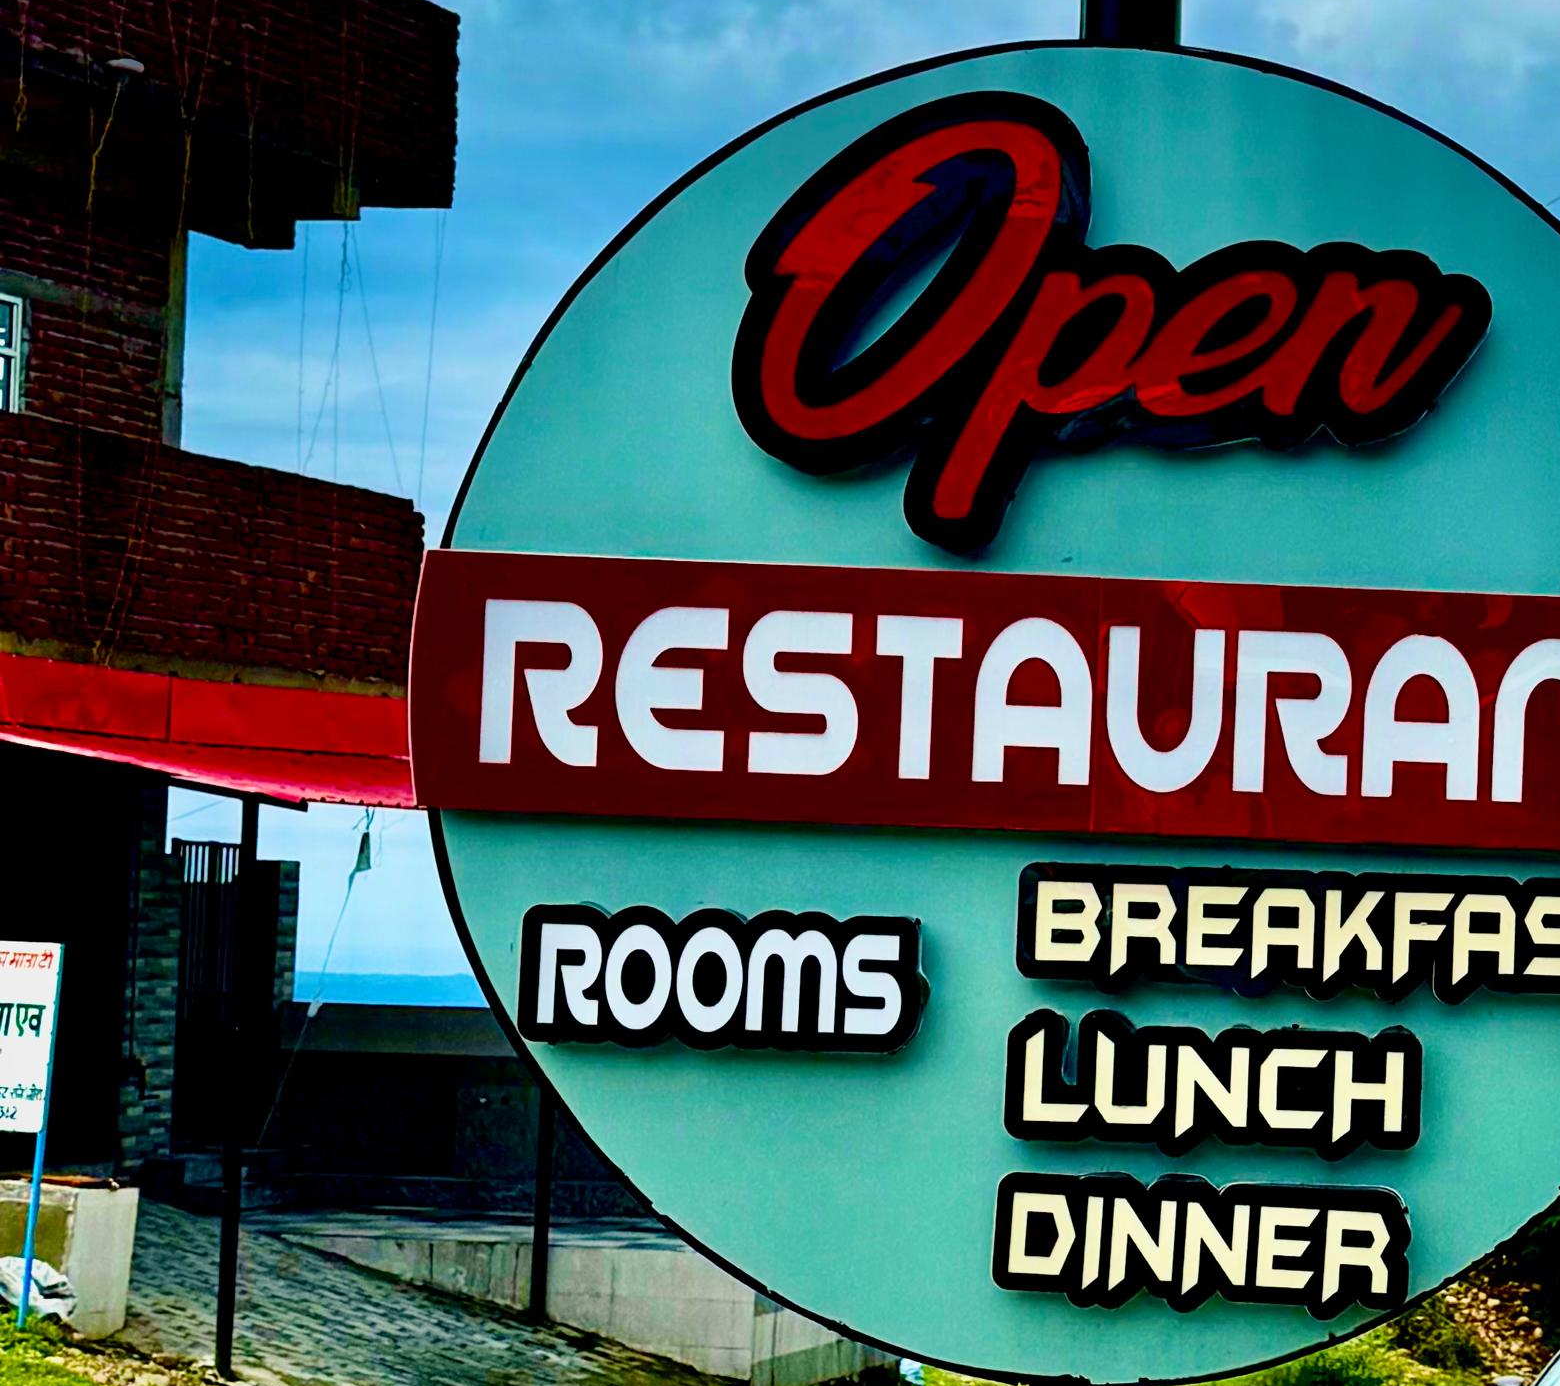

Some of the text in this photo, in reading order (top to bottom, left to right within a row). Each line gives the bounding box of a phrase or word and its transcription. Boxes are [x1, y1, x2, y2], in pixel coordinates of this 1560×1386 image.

[755, 116, 1464, 522] Open
[534, 921, 904, 1037] ROOMS
[1022, 1029, 1404, 1144] LUNCH
[1008, 1191, 1392, 1301] DINNER
